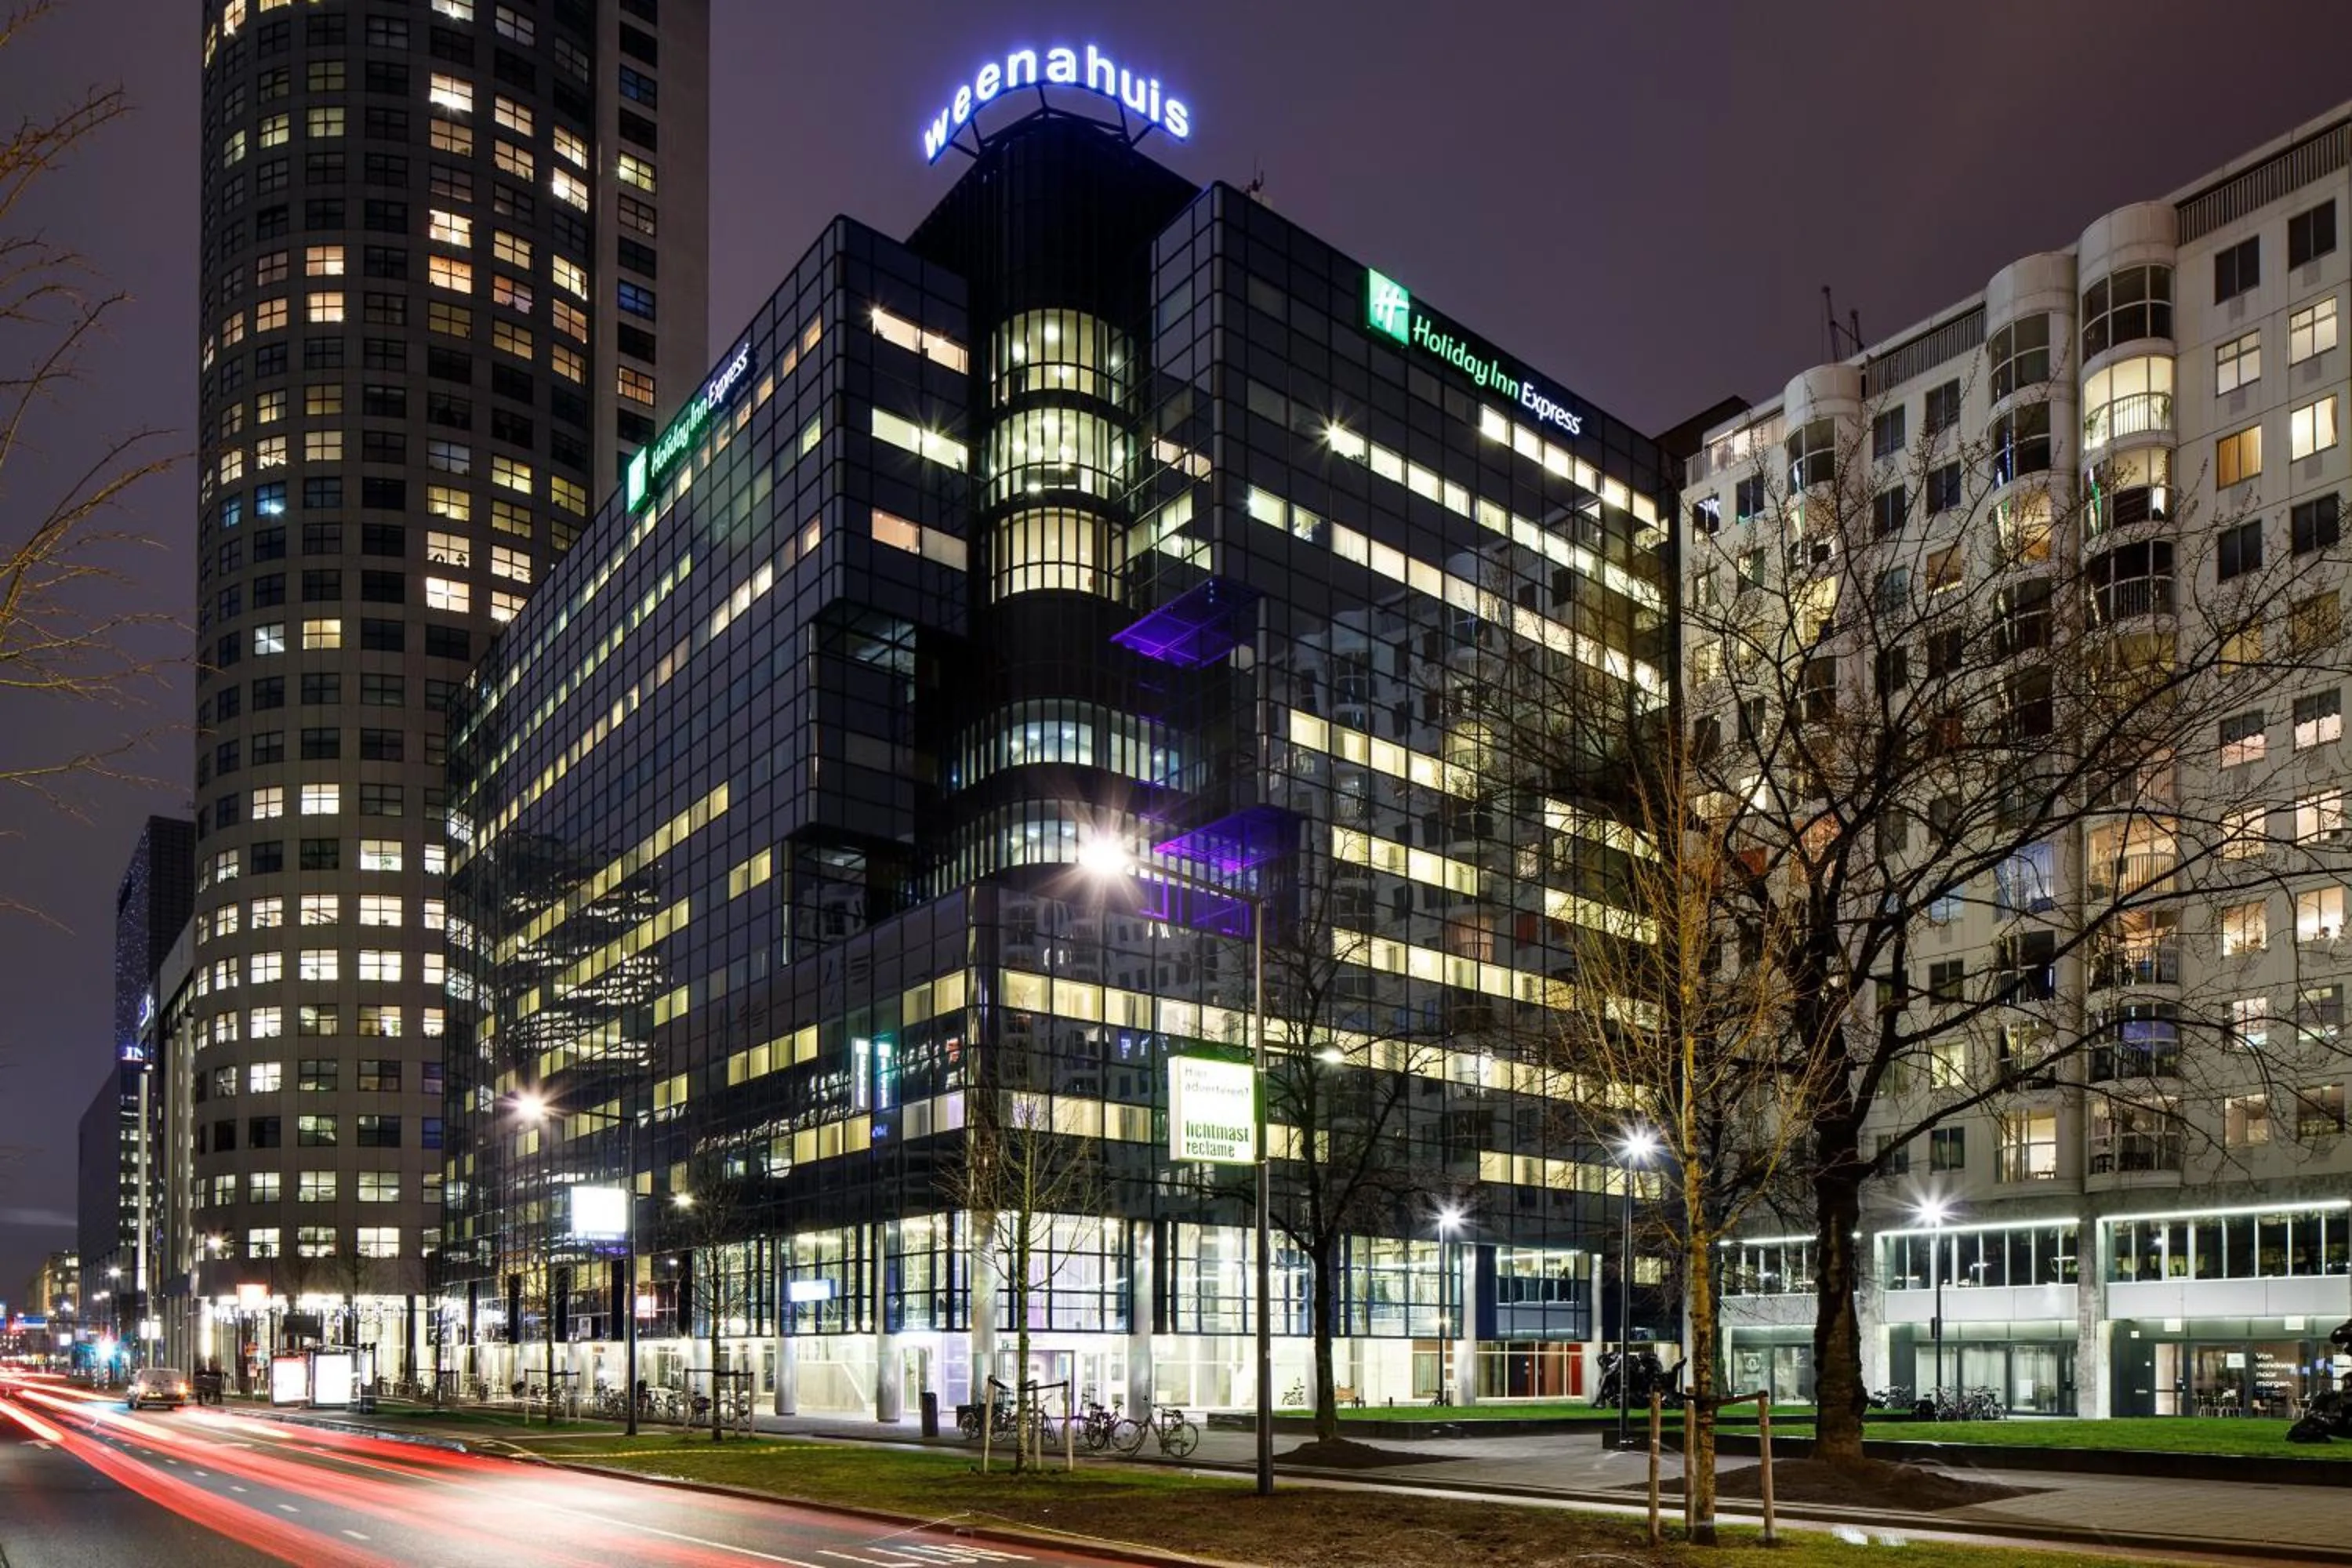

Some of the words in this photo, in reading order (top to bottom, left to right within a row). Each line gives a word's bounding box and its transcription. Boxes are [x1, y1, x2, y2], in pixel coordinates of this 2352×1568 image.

[924, 44, 1189, 159] weenahuis
[652, 419, 690, 477] Holiday
[690, 397, 708, 432] Inn
[708, 345, 750, 409] Express
[1413, 314, 1489, 386] Holiday
[1490, 359, 1519, 401] Inn
[1520, 381, 1582, 435] Express
[1185, 1120, 1250, 1142] lichtmast
[1185, 1139, 1236, 1158] reclame
